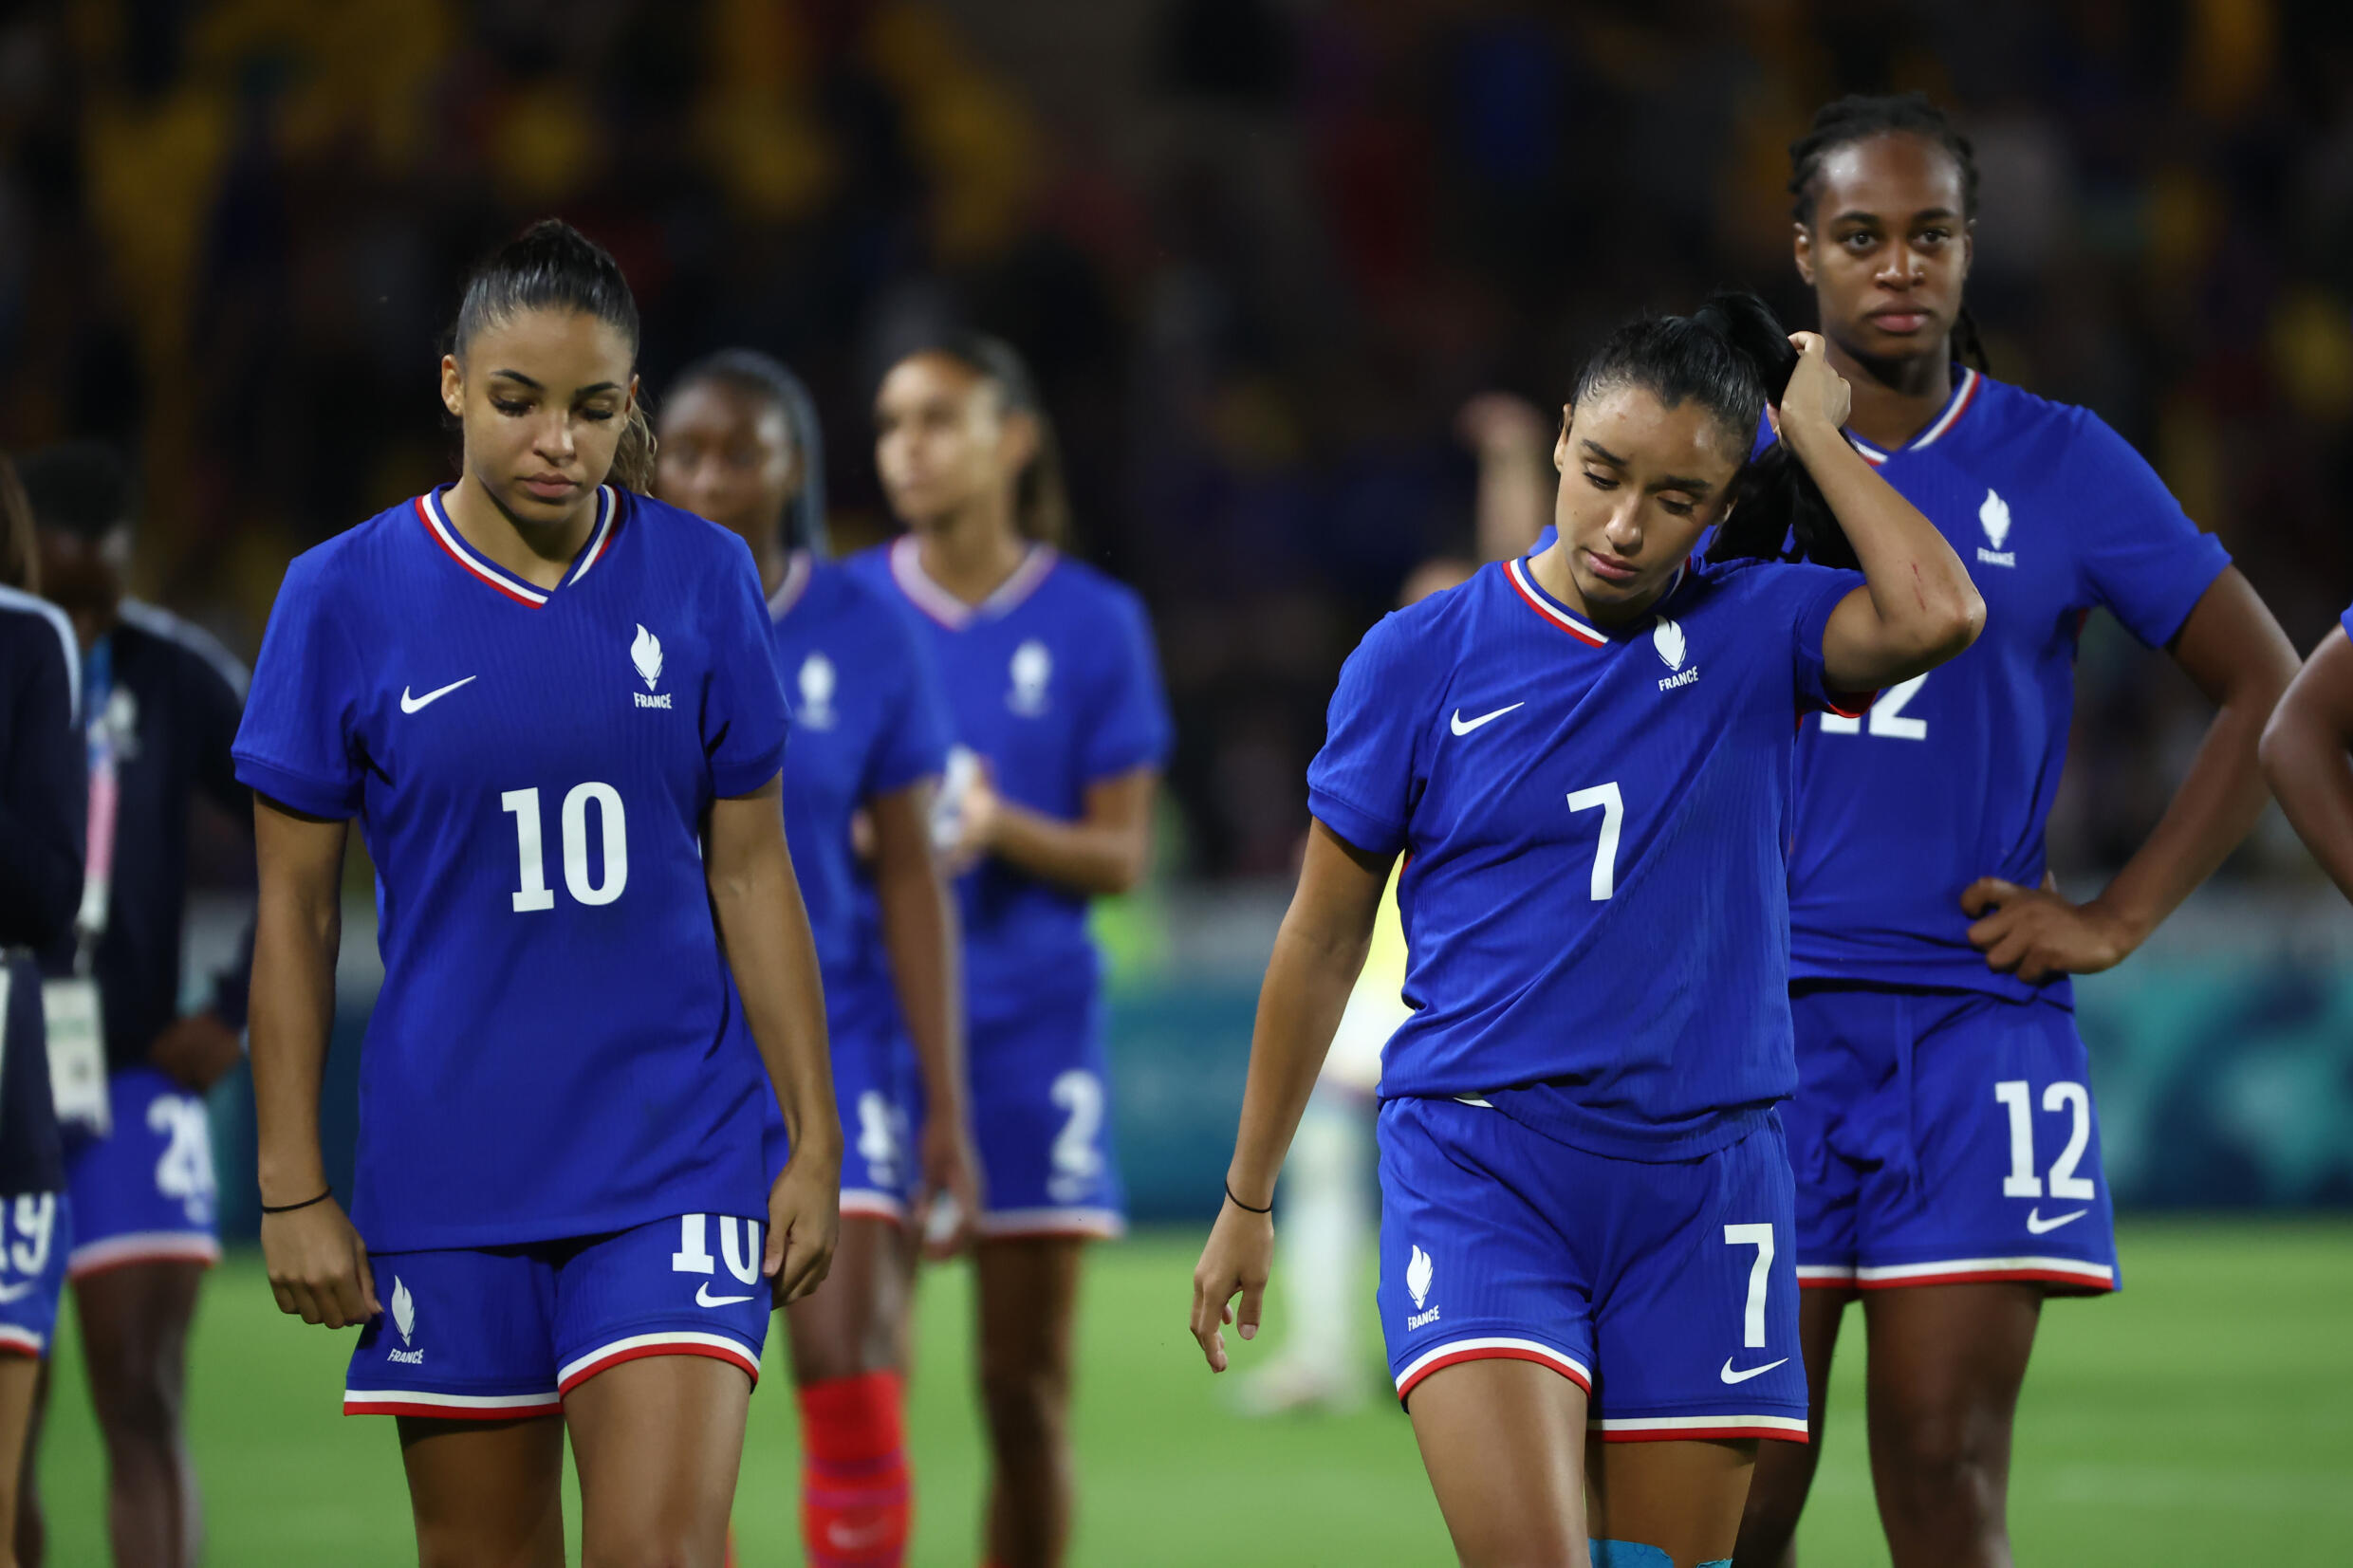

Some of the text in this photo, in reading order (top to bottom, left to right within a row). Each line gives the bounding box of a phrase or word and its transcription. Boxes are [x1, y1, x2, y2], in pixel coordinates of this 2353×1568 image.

[633, 692, 672, 709] FRANCE
[1658, 665, 1699, 692] FRANCE
[501, 781, 628, 913] 10
[1566, 782, 1623, 900] 7
[1994, 1080, 2095, 1200] 12
[1408, 1305, 1440, 1332] FRANCE
[1724, 1223, 1774, 1348] 7
[387, 1348, 424, 1364] FRANCE
